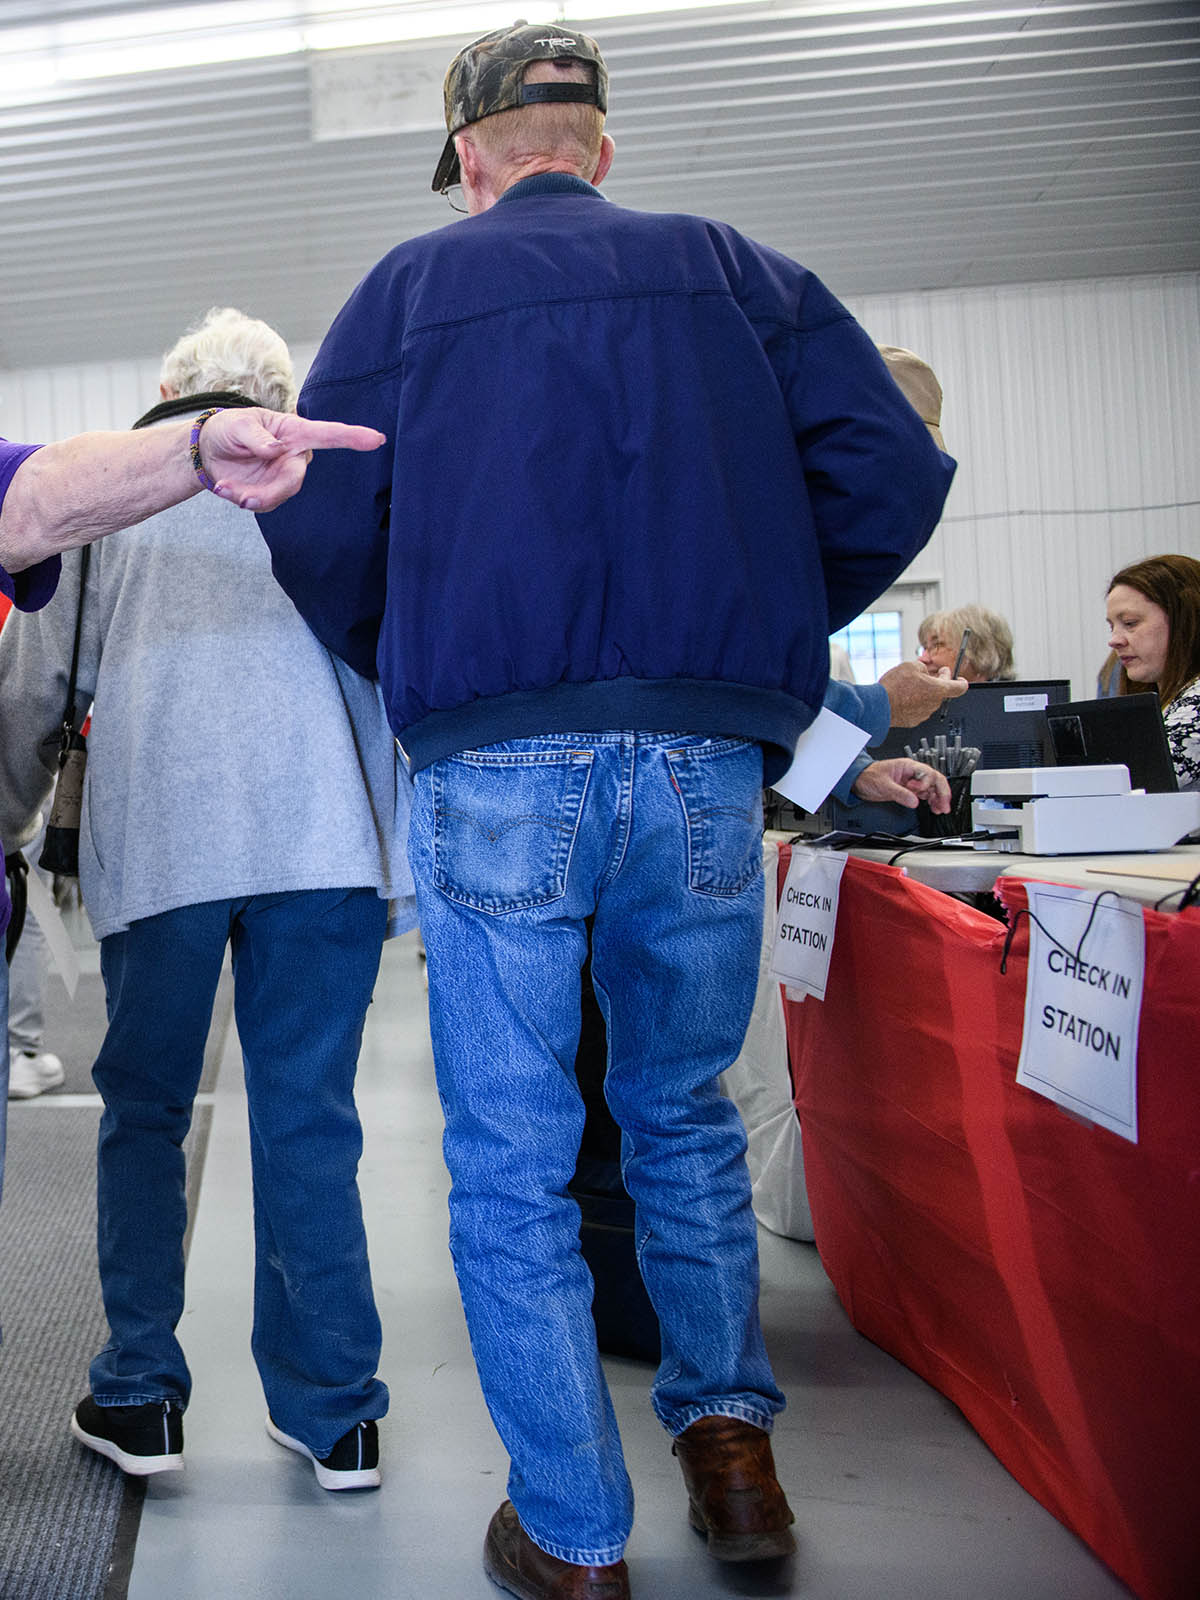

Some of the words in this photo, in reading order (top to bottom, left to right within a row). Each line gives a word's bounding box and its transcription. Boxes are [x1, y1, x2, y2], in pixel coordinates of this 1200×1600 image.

[786, 887, 821, 911] CHECK
[822, 898, 832, 913] IN
[780, 923, 828, 951] STATION
[1047, 949, 1111, 992] CHECK
[1112, 973, 1132, 999] IN
[1042, 1004, 1121, 1061] STATION
